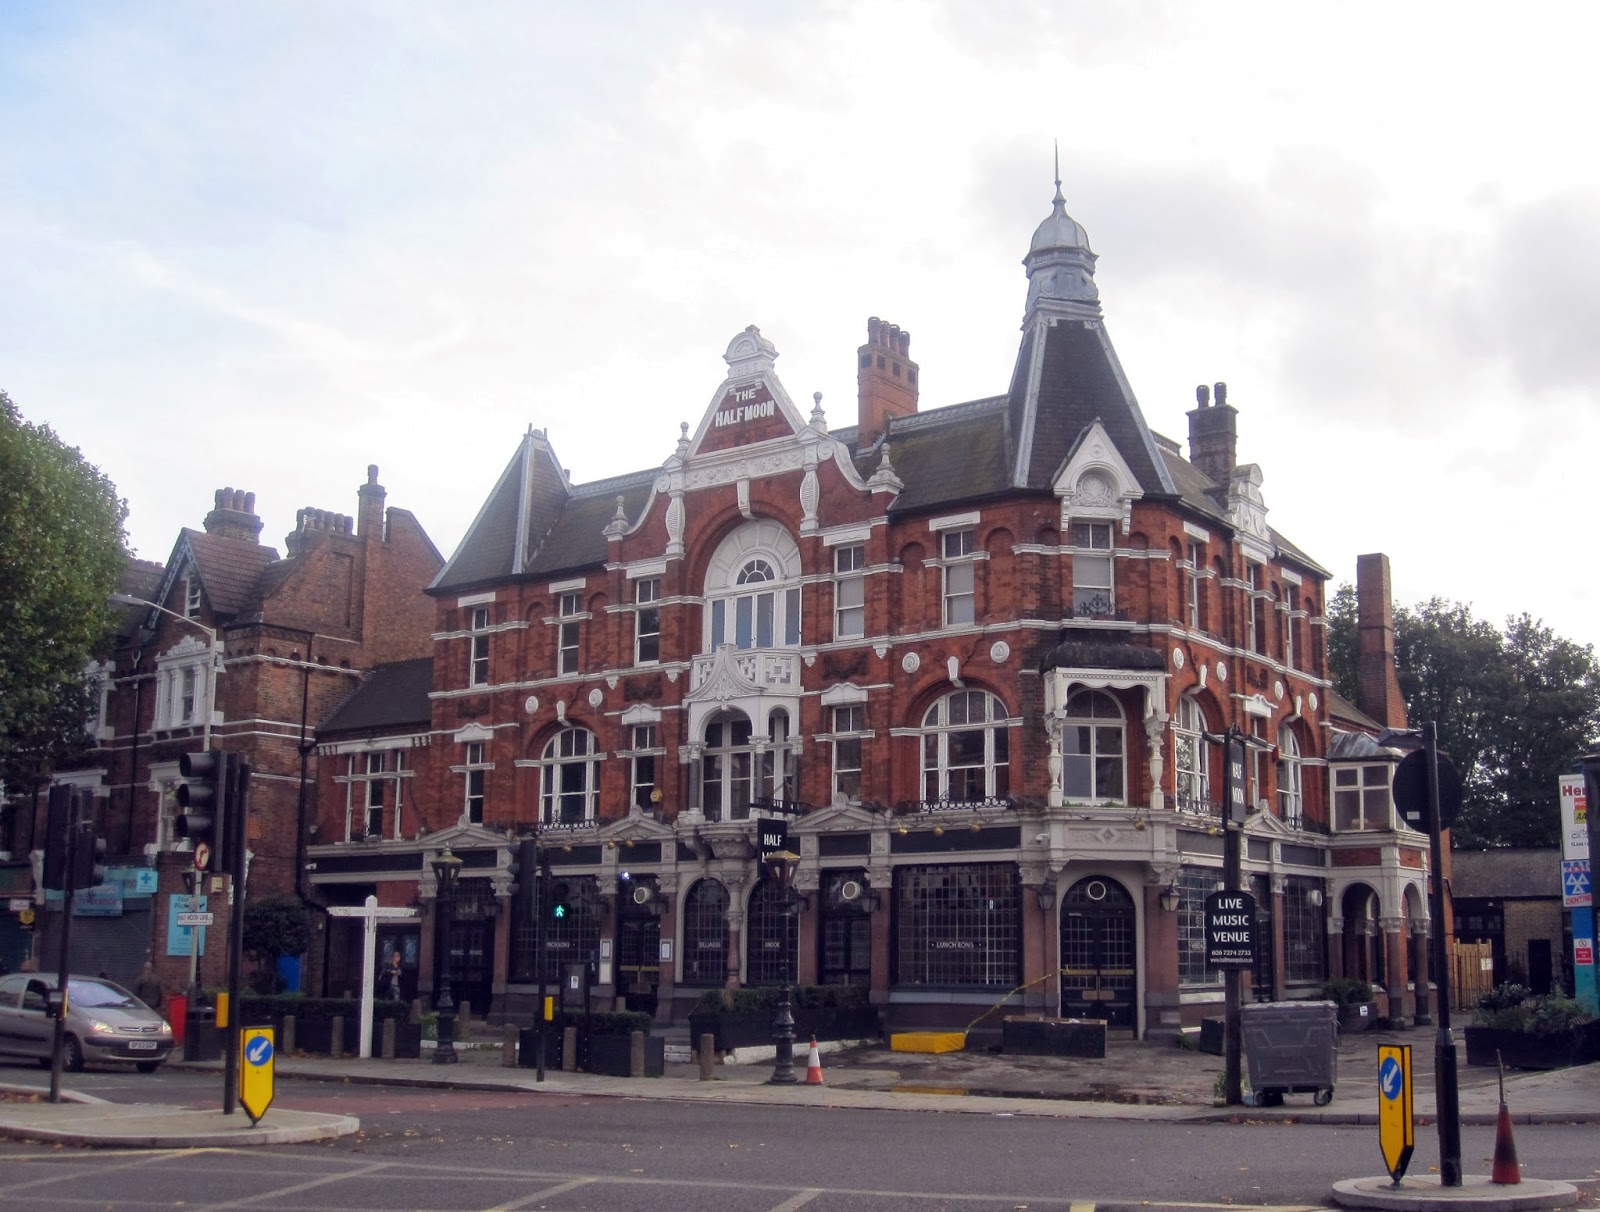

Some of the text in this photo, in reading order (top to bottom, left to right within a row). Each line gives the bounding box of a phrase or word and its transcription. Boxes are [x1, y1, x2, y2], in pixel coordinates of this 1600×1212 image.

[735, 388, 757, 401] THE
[715, 400, 775, 427] HALF MOON
[763, 833, 782, 847] HALF
[1218, 898, 1243, 909] LIVE
[1212, 915, 1249, 926] MUSIC
[1212, 931, 1250, 943] VENUE
